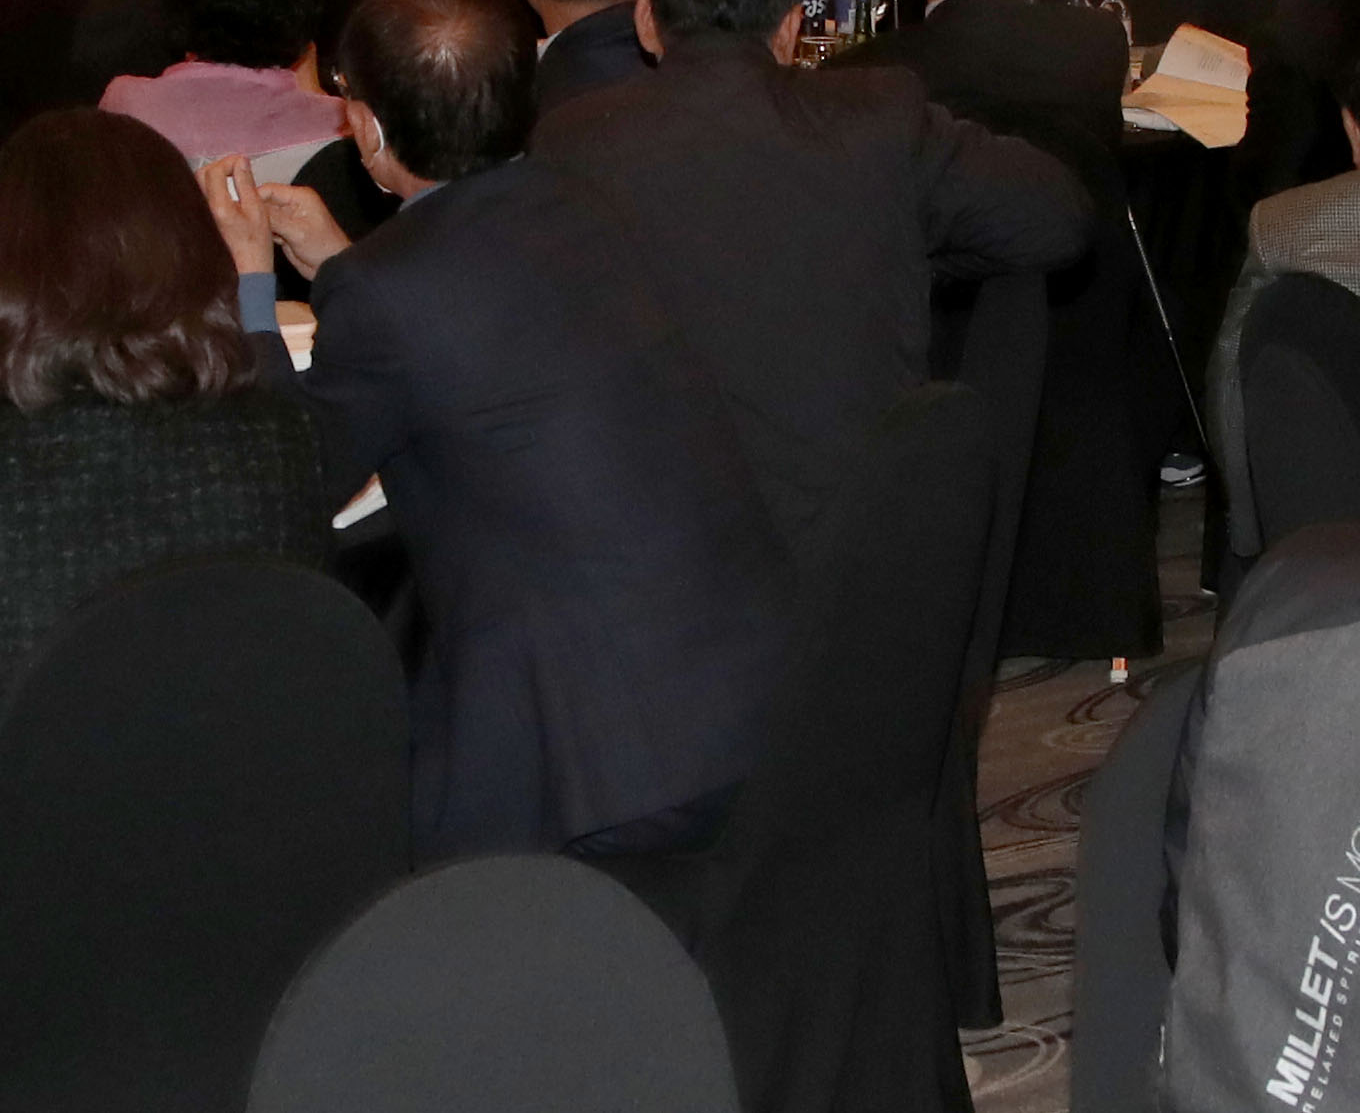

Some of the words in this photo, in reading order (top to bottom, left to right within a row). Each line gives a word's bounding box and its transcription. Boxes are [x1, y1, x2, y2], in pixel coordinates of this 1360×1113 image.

[1266, 935, 1339, 1107] MILLET
[1320, 892, 1357, 944] IS
[1303, 1014, 1344, 1113] RELAXED
